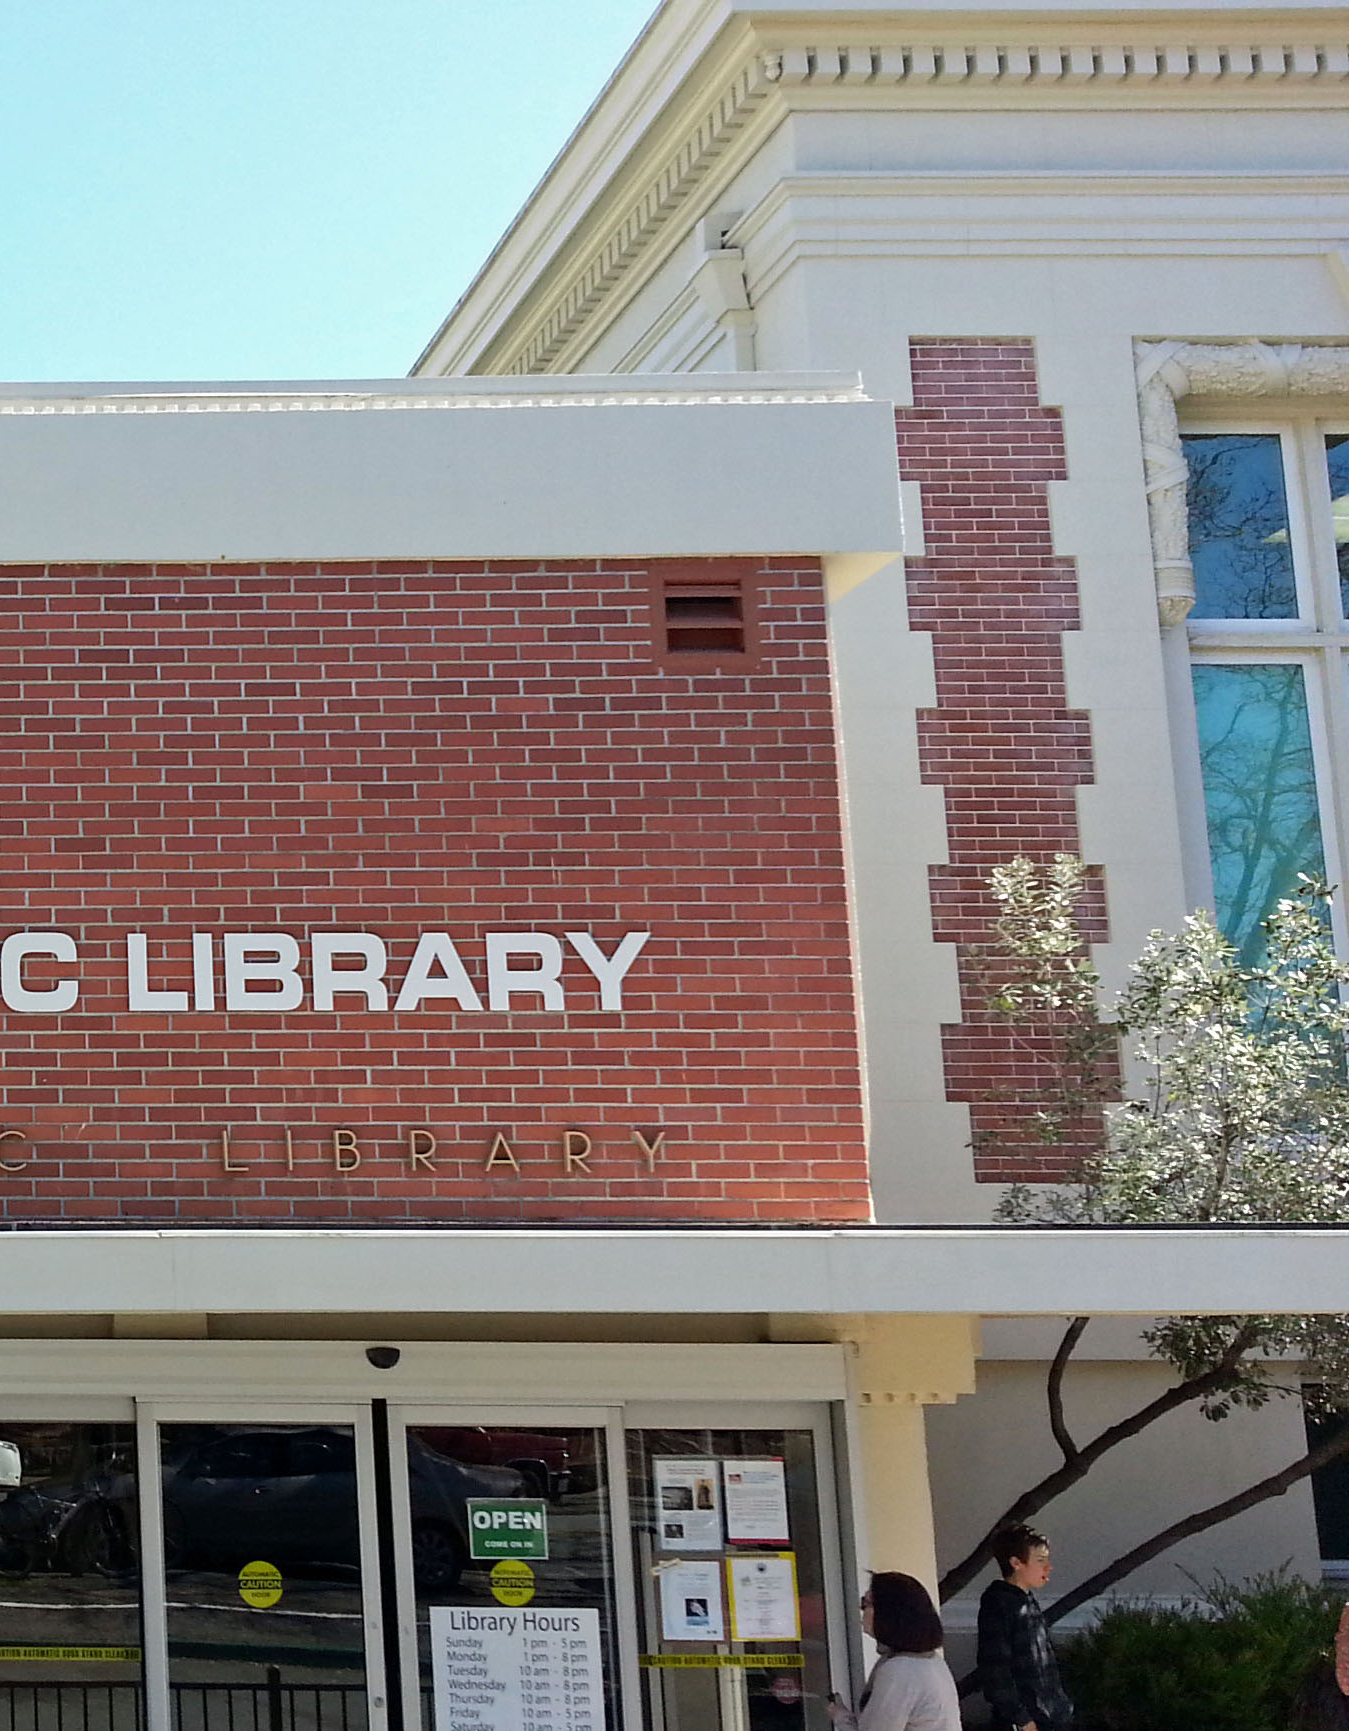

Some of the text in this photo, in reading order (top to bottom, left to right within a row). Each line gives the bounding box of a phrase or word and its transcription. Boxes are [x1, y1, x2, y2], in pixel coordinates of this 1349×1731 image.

[127, 931, 651, 1013] LIBRARY
[222, 1129, 666, 1173] LIBRARY
[473, 1511, 542, 1529] OPEN
[241, 1580, 282, 1589] CAUTION
[492, 1579, 534, 1587] CAUTION
[450, 1611, 580, 1635] Library Hours
[446, 1636, 483, 1649] Sunday
[530, 1640, 547, 1649] pm
[561, 1638, 567, 1647] 5
[569, 1640, 586, 1649] pm
[447, 1651, 488, 1663] Monday
[531, 1654, 548, 1663] pm
[562, 1652, 567, 1661] 8
[571, 1654, 588, 1663] pm
[447, 1665, 488, 1678] Tuesday
[520, 1666, 532, 1675] 10
[563, 1667, 568, 1676] 8
[572, 1668, 588, 1677] pm
[448, 1679, 506, 1692] Wednesday
[520, 1680, 533, 1690] 10
[535, 1682, 550, 1690] am
[563, 1681, 569, 1690] 8
[573, 1682, 589, 1691] pm
[449, 1693, 495, 1705] Thursday
[521, 1694, 533, 1704] 10
[535, 1696, 550, 1704] am
[565, 1695, 570, 1704] 8
[574, 1697, 590, 1706] pm
[450, 1707, 481, 1719] Friday
[522, 1708, 534, 1718] 10
[536, 1710, 552, 1718] am
[565, 1709, 571, 1718] 5
[574, 1711, 591, 1720] pm
[451, 1722, 496, 1731] Saturday
[523, 1723, 535, 1731] 10
